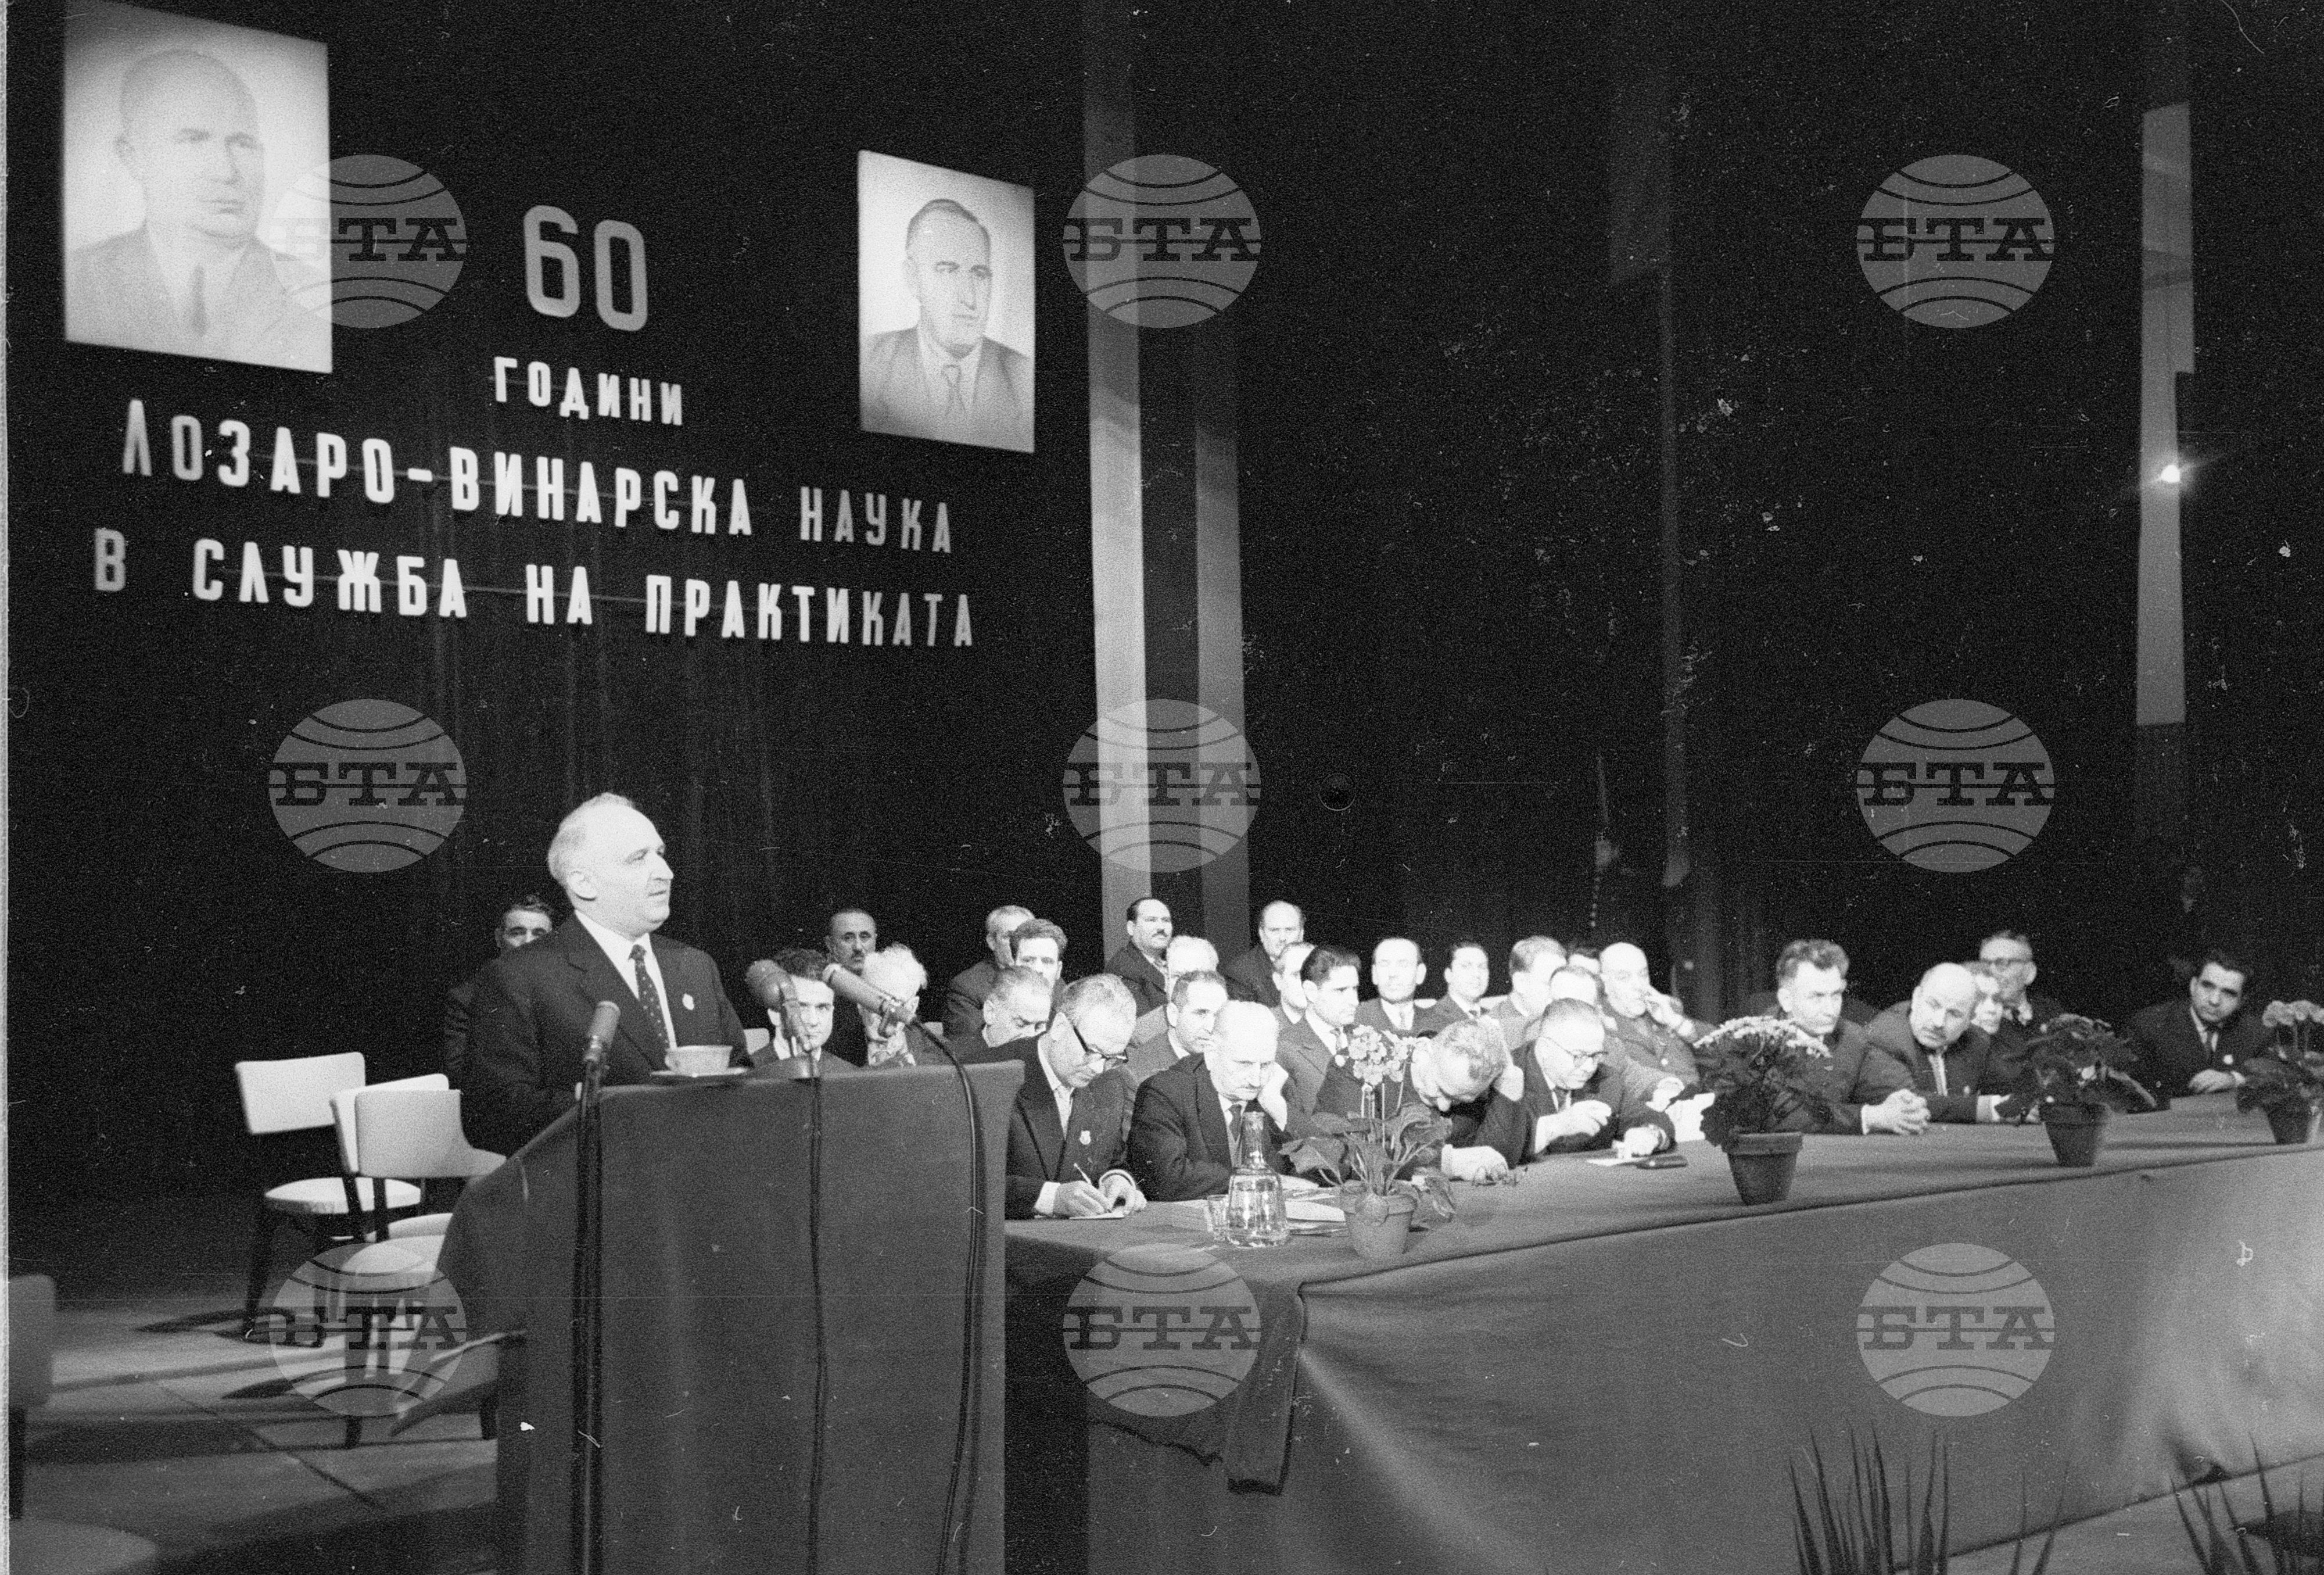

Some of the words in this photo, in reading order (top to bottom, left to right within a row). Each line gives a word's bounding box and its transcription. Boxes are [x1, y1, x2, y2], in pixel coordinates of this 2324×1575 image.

[523, 205, 648, 332] 60
[493, 355, 683, 427] ГОДИНИ
[123, 399, 752, 536] ЛОЗАРО-ВИНАРСКА
[799, 486, 951, 554] НАУКА
[95, 527, 126, 592] В
[192, 538, 468, 619] СЛУЖБА
[523, 563, 593, 625] НА
[644, 573, 973, 647] ПРАКТИКАТА
